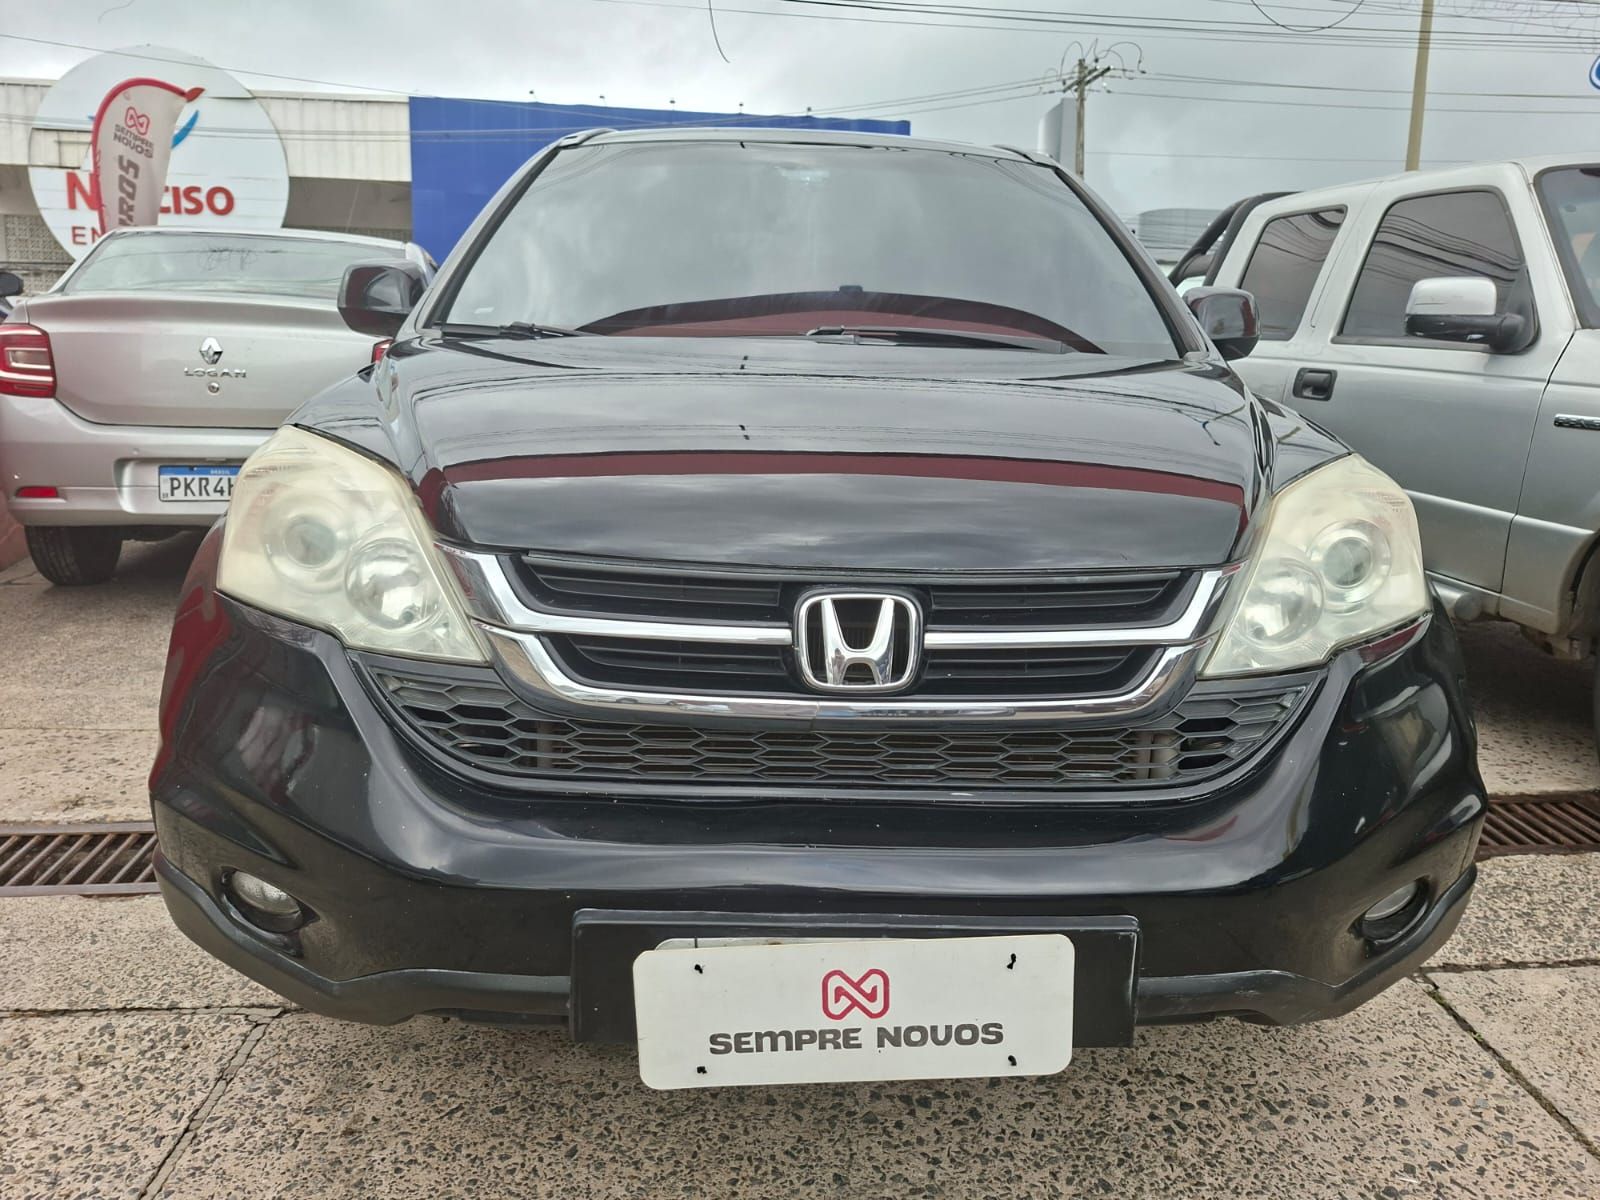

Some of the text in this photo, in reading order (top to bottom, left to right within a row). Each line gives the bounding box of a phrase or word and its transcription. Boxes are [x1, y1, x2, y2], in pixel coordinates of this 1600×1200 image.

[114, 123, 154, 149] SEMPRE
[184, 367, 247, 378] LOGAN
[709, 1022, 1004, 1055] SEMPRE NOVOS
